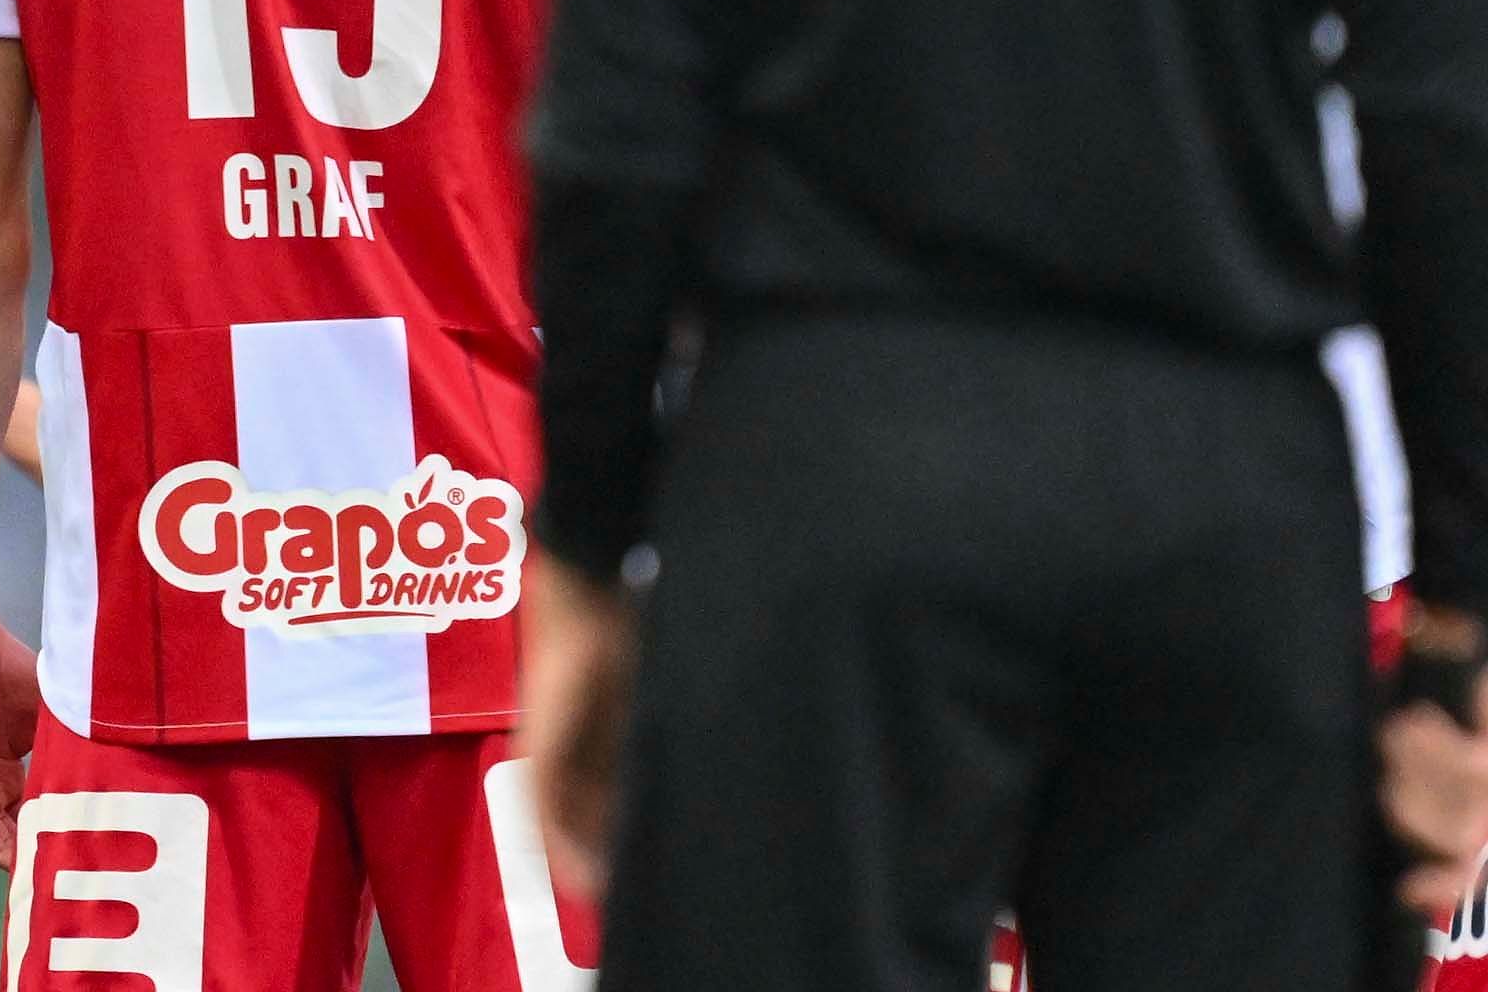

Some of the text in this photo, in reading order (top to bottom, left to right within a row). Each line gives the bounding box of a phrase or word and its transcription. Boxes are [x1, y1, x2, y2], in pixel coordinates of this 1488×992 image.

[222, 152, 384, 241] GRAF
[239, 568, 505, 612] SOFT DRINKS
